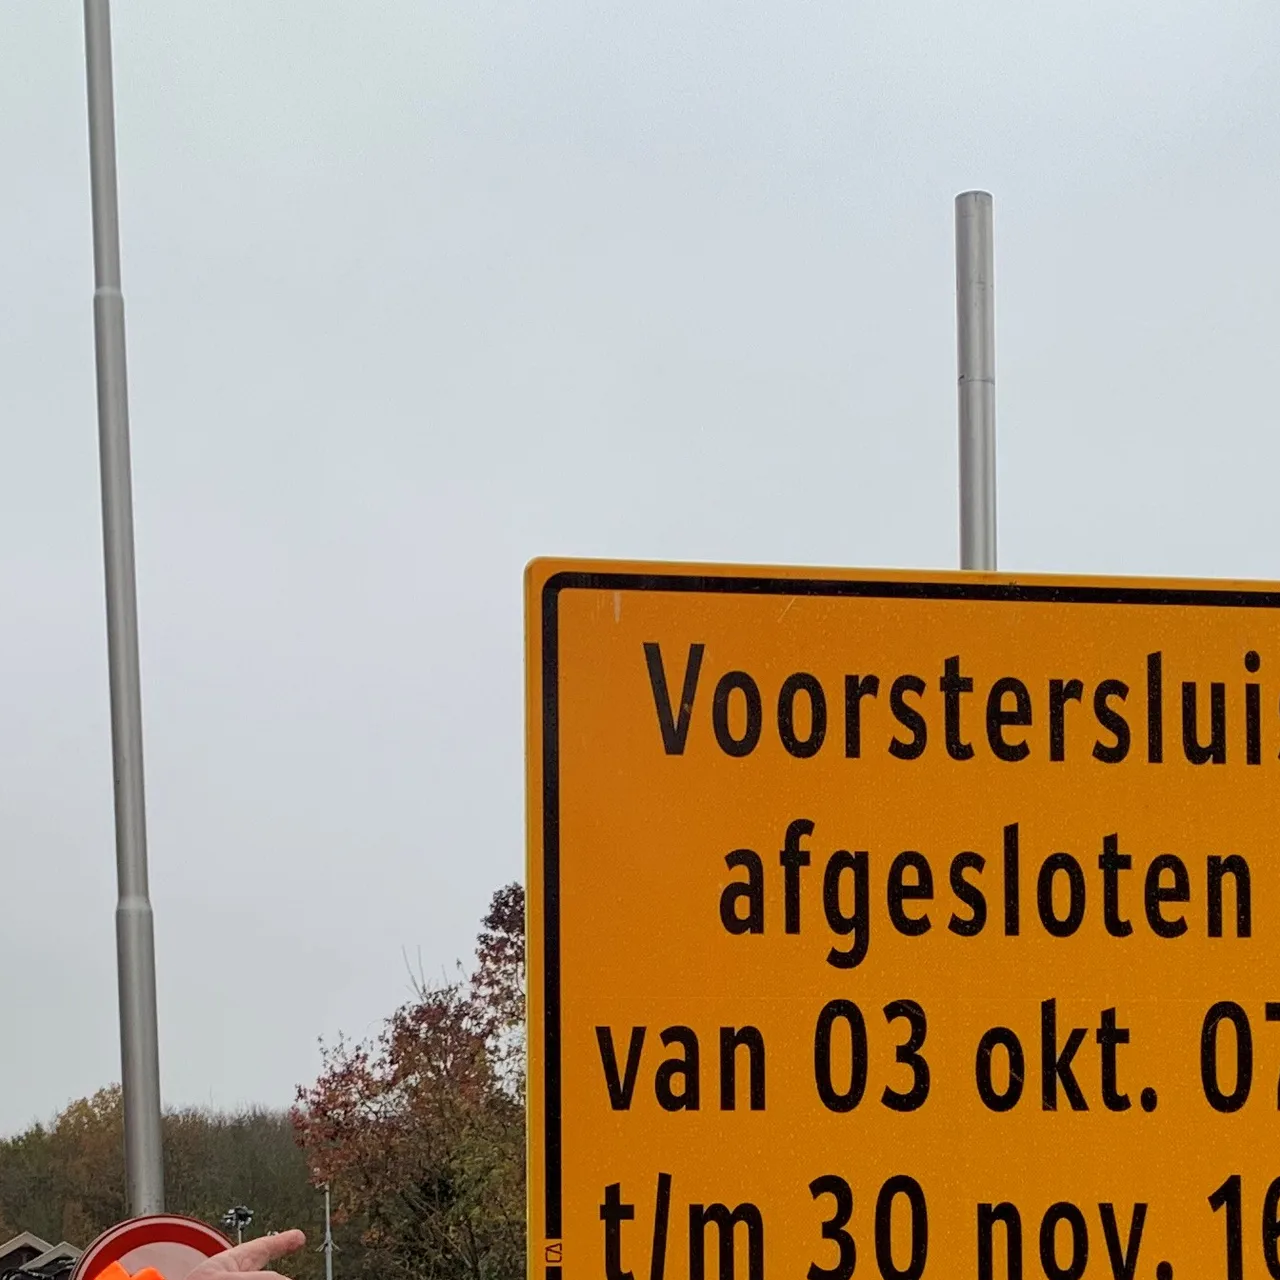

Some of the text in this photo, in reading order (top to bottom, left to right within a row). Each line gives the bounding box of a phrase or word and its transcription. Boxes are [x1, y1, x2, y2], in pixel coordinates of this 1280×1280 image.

[719, 818, 1252, 970] afgesloten
[595, 1025, 766, 1112] van
[814, 998, 931, 1113] 03
[975, 997, 1158, 1113] okt.
